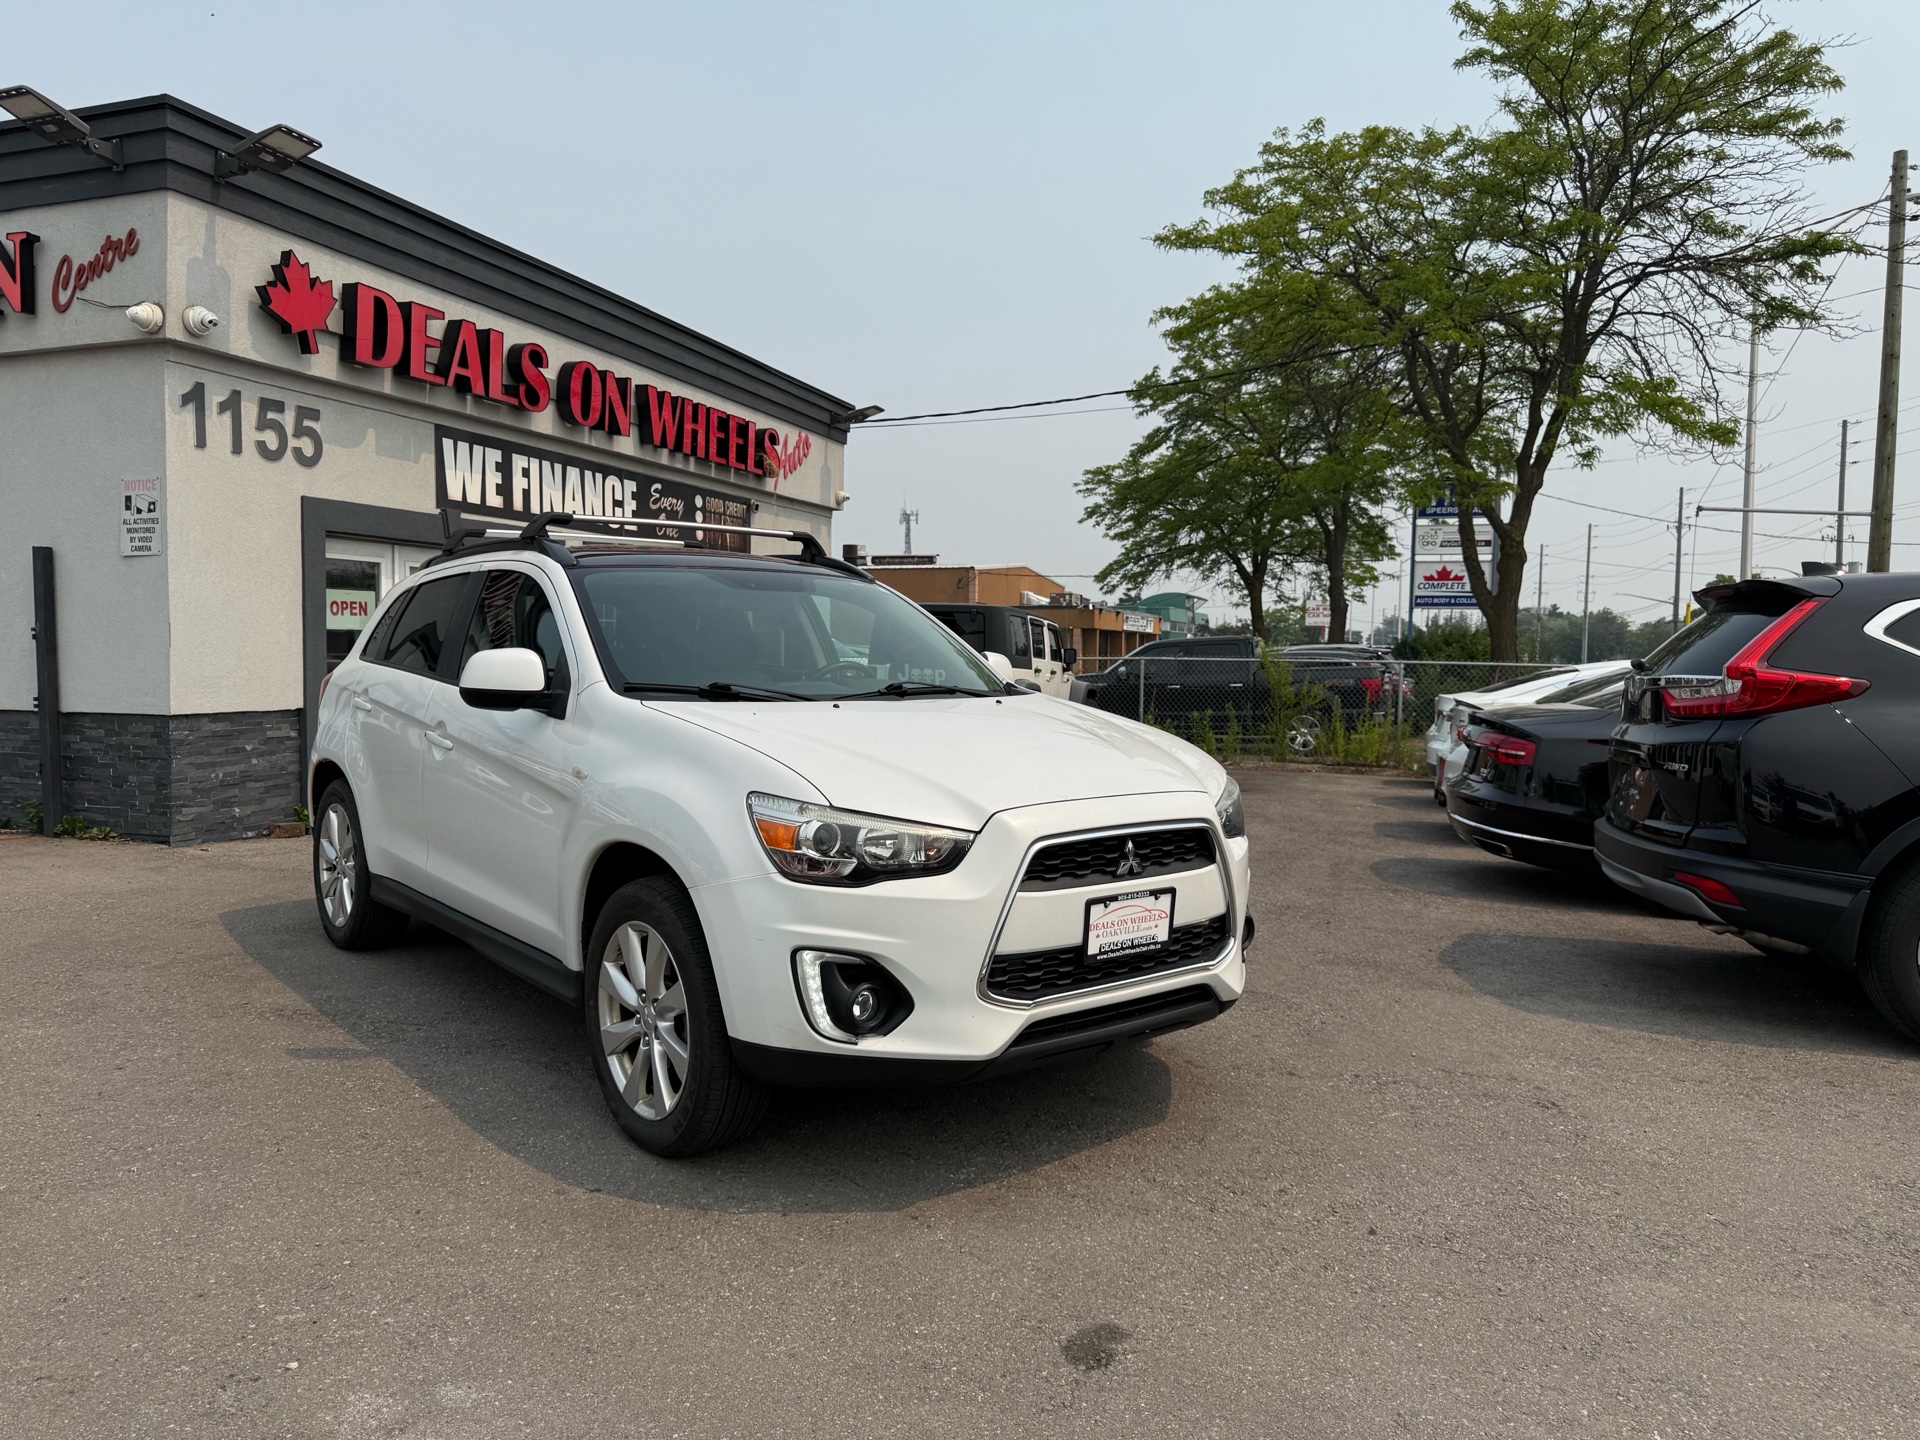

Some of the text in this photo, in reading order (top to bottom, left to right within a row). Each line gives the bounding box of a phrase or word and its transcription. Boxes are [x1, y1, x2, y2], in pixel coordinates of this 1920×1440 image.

[52, 227, 140, 313] Centre
[344, 281, 811, 491] DEALS ON WHEELS Auto
[179, 381, 324, 467] 1155
[124, 479, 157, 491] NOTICE
[442, 437, 638, 532] WE FINANCE
[649, 483, 685, 520] Every
[705, 496, 748, 518] GOOD CREDIT
[1425, 506, 1459, 514] SPEERS
[122, 517, 159, 526] ALL ACTIVITIES
[126, 527, 156, 535] MONITORED
[129, 536, 153, 544] BY VIDEO
[130, 545, 152, 553] CAMERA
[1417, 582, 1467, 590] COMPLETE
[329, 600, 368, 617] OPEN
[1090, 912, 1163, 931] DEALS ON WHEELS
[1101, 925, 1153, 938] OAKVILLE.com
[1101, 934, 1159, 952] DEALS ON WHEELS
